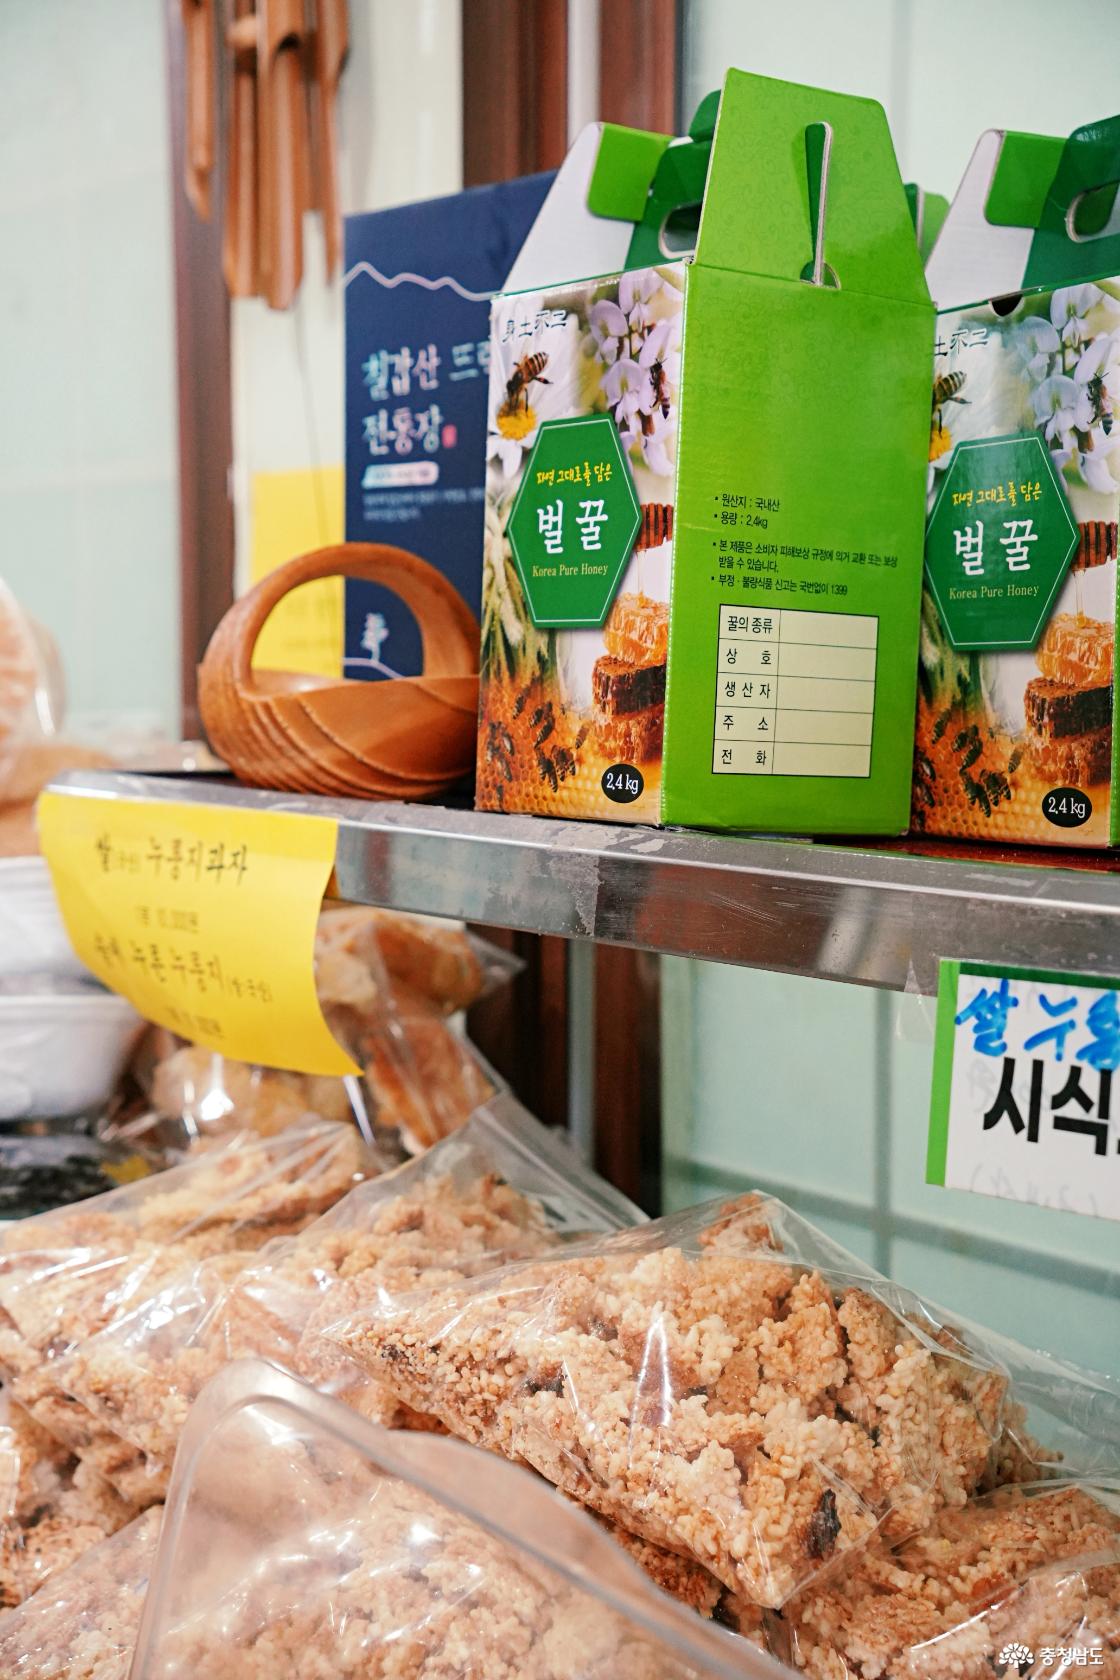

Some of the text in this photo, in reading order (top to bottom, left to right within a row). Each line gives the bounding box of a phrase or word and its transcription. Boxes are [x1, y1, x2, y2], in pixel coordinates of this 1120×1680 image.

[361, 403, 444, 455] 전통장
[536, 462, 612, 486] 자연 그대로를 담은
[721, 494, 747, 509] 원산지
[755, 497, 780, 512] 국내산
[952, 481, 1042, 507] 자연 그대로를 담은
[720, 511, 738, 525] 용량
[718, 556, 779, 573] 받을 수 있습니다.
[719, 540, 898, 568] 본 제품은 소비자 피해보상 규정에 의거 교환 또는 보상
[532, 563, 608, 577] Korea Pure Honey
[719, 574, 735, 587] 부정
[742, 575, 773, 590] 불량식품
[775, 579, 797, 592] 신고는
[799, 581, 829, 595] 국번없이
[831, 584, 848, 596] 1399
[949, 584, 1040, 600] Korea Pure Honey
[727, 615, 773, 634] 꿀의 종류
[955, 978, 1019, 1057] 쌀
[982, 1056, 1120, 1156] 시식
